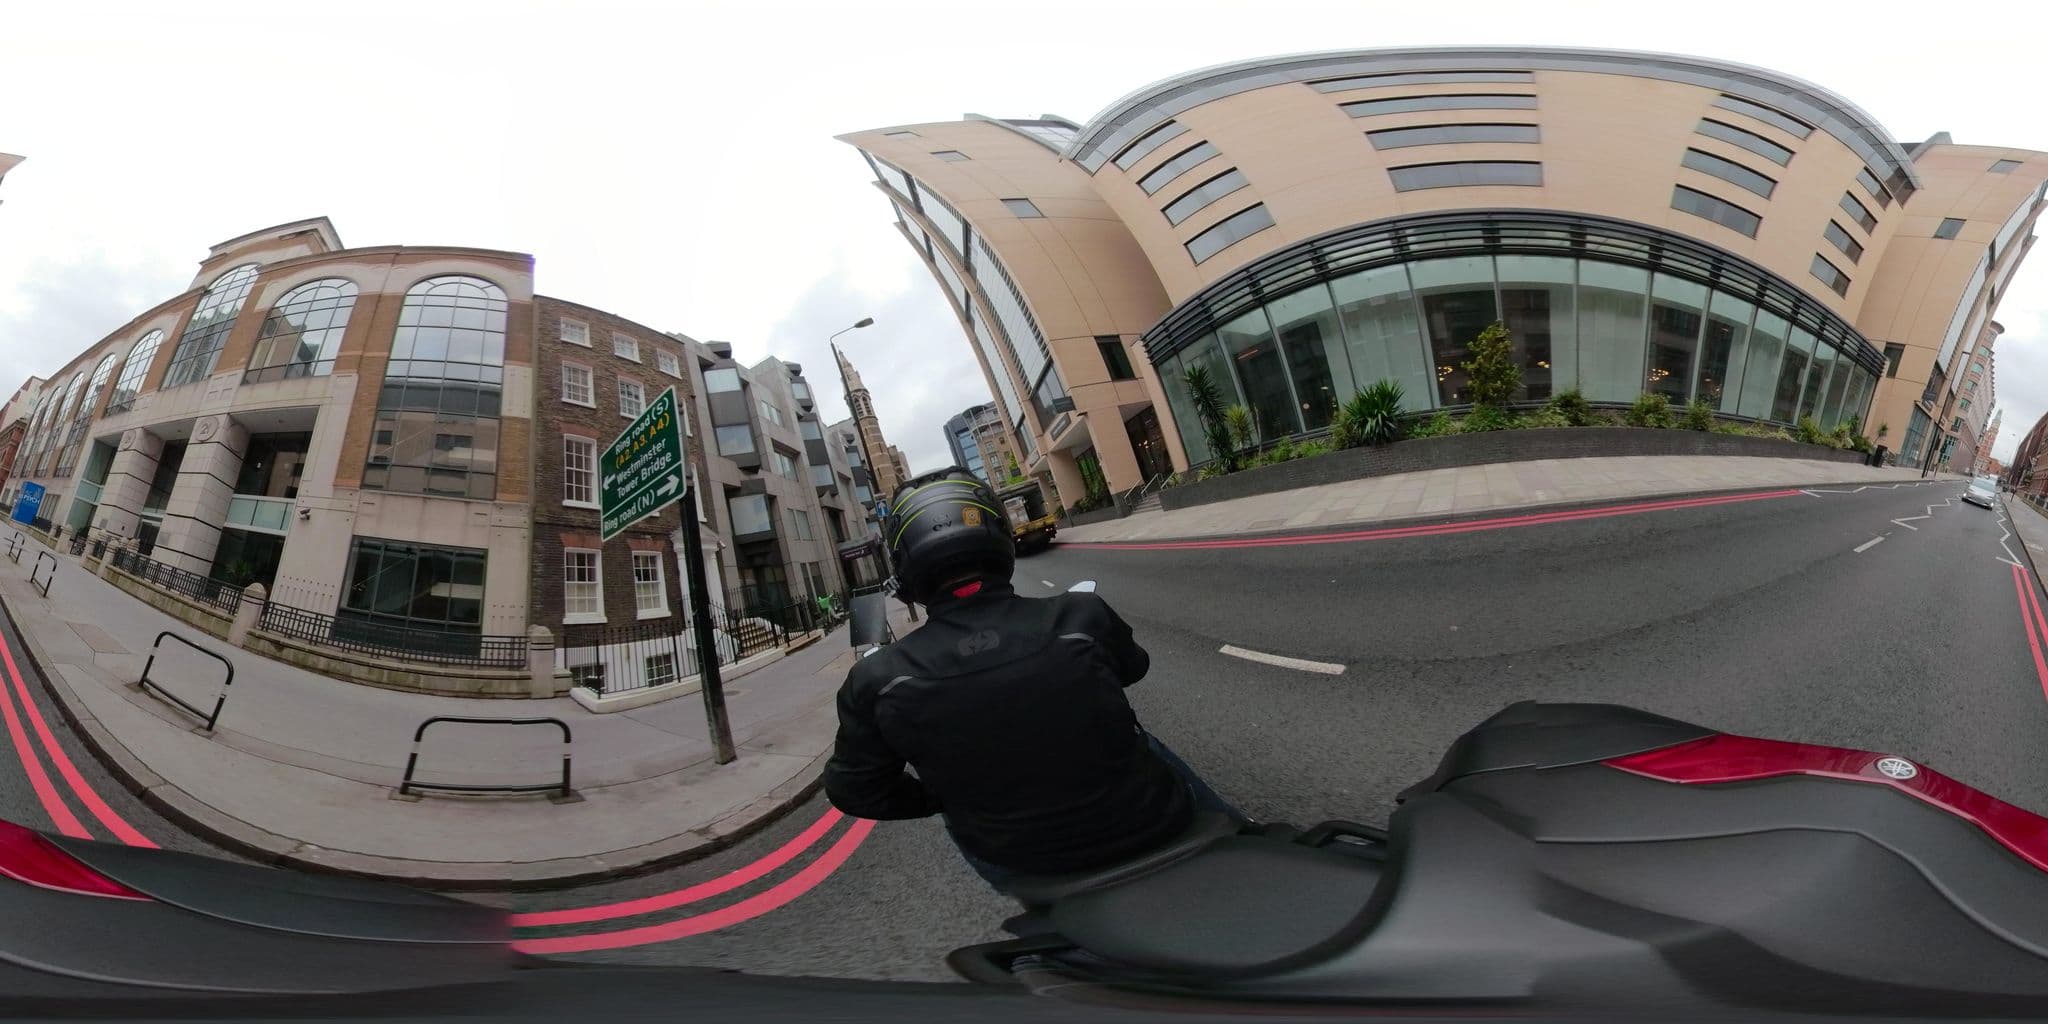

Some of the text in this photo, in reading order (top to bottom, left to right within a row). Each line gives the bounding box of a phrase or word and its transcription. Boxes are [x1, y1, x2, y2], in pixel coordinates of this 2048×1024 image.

[615, 436, 631, 455] Ring
[632, 414, 650, 439] road
[617, 438, 666, 485] Westminster
[617, 452, 672, 499] Tower Bridge
[604, 517, 618, 533] Ring
[619, 502, 636, 523] road
